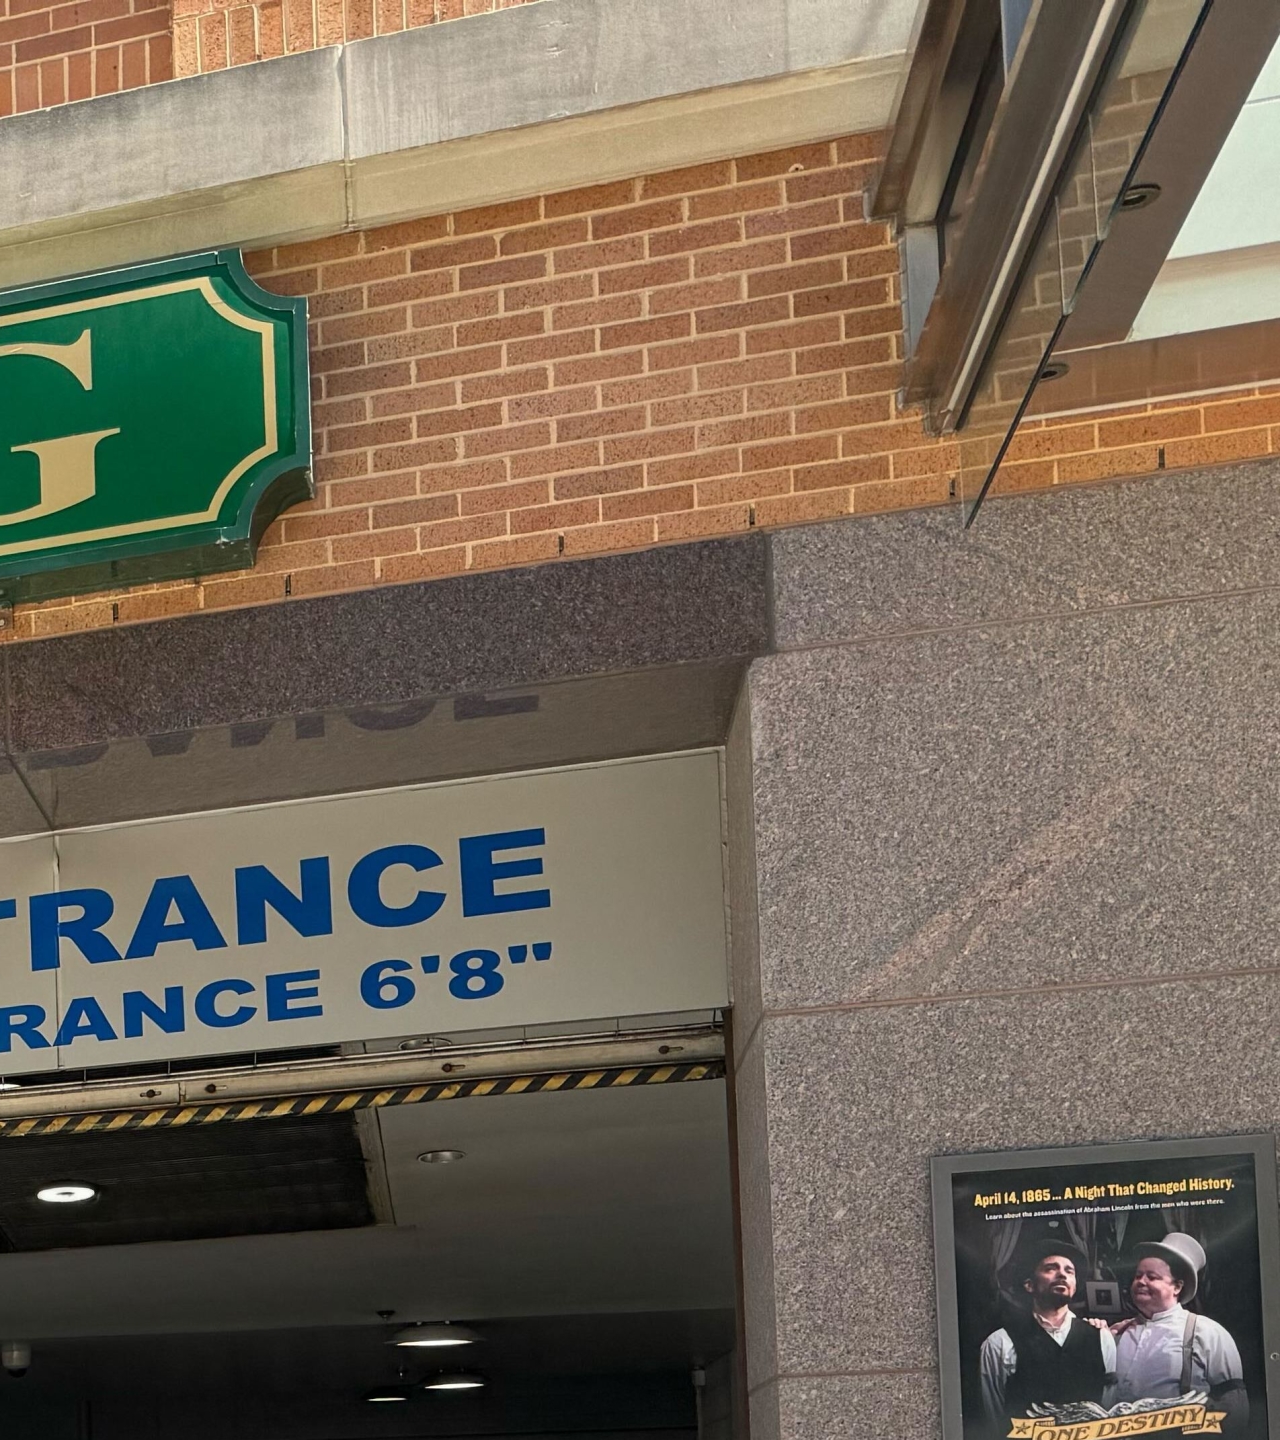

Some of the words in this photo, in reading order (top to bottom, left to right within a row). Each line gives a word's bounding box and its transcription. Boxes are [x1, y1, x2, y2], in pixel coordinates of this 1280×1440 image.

[357, 941, 554, 1010] 6'8"
[974, 1192, 1002, 1208] April
[1004, 1190, 1020, 1205] 14,
[1064, 1187, 1073, 1200] A
[1075, 1184, 1106, 1201] Night
[1108, 1183, 1134, 1197] That
[1137, 1180, 1186, 1197] Changed
[1189, 1177, 1235, 1192] History.
[1097, 1406, 1204, 1436] DESTINY
